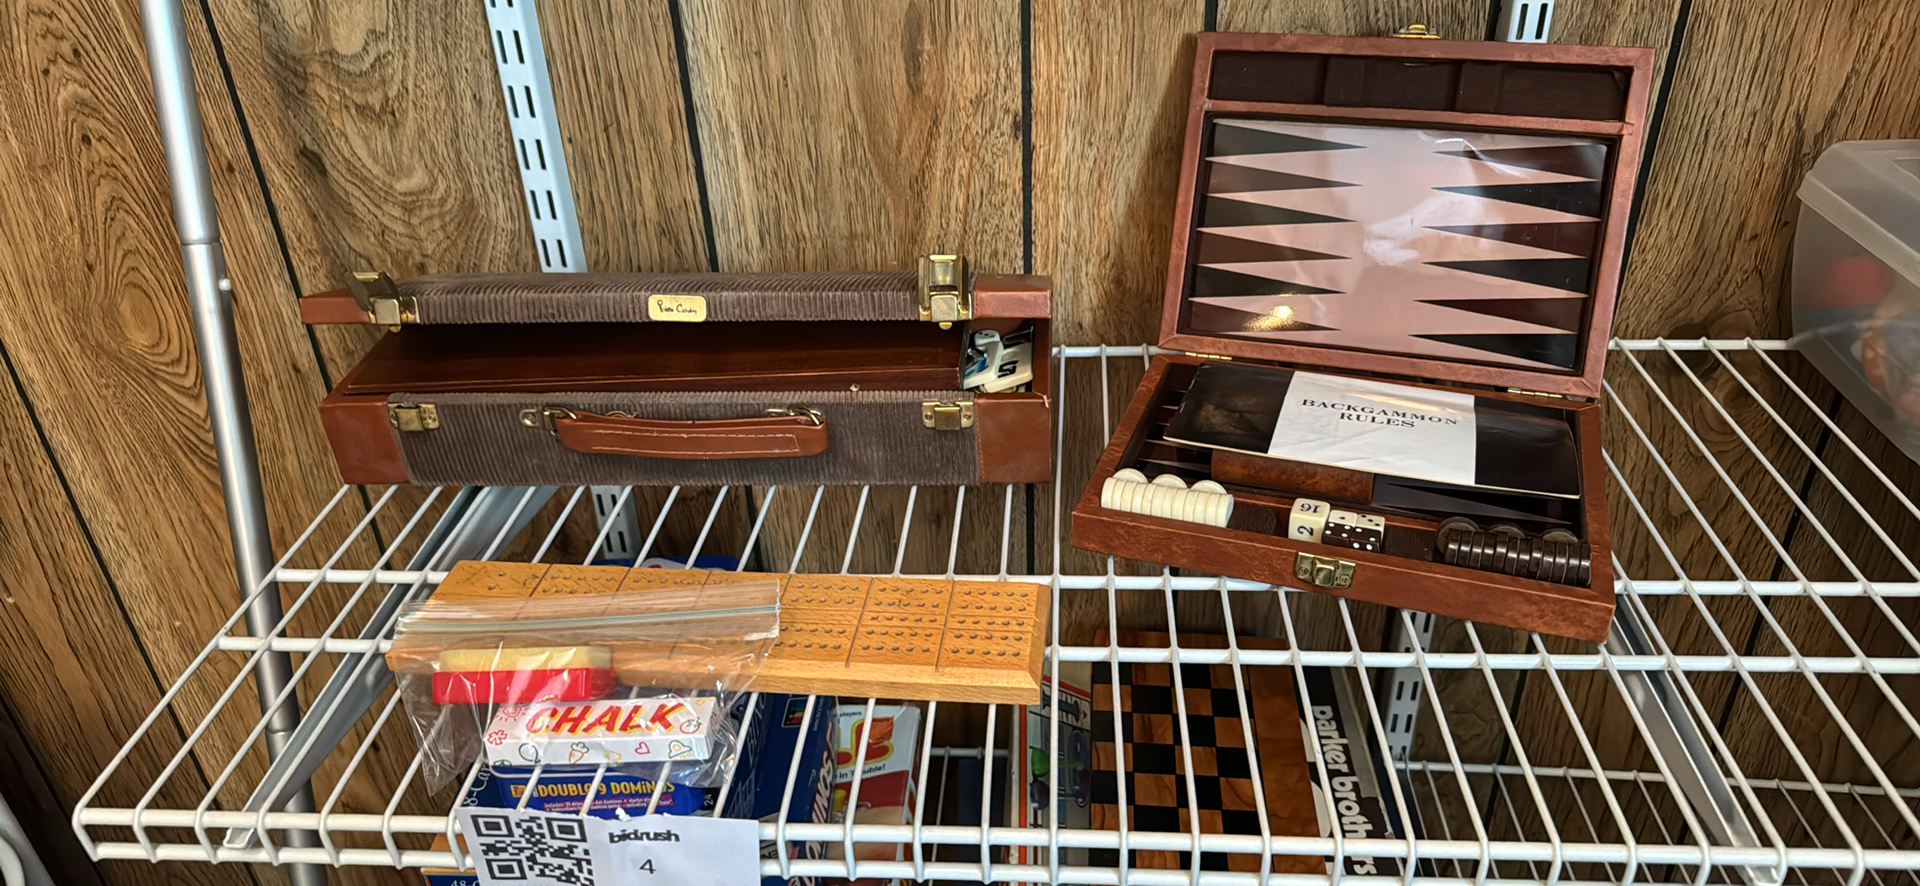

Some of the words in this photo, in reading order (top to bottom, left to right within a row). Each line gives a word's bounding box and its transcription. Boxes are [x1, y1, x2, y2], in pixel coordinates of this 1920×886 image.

[1301, 399, 1458, 425] BACKGAMMON
[1339, 412, 1416, 428] RULES
[1300, 503, 1321, 513] 16
[1297, 525, 1314, 536] 2
[525, 702, 686, 735] CHALK
[1312, 705, 1350, 773] parker
[598, 782, 607, 795] 9
[608, 829, 680, 843] bidrush
[639, 859, 656, 874] 4
